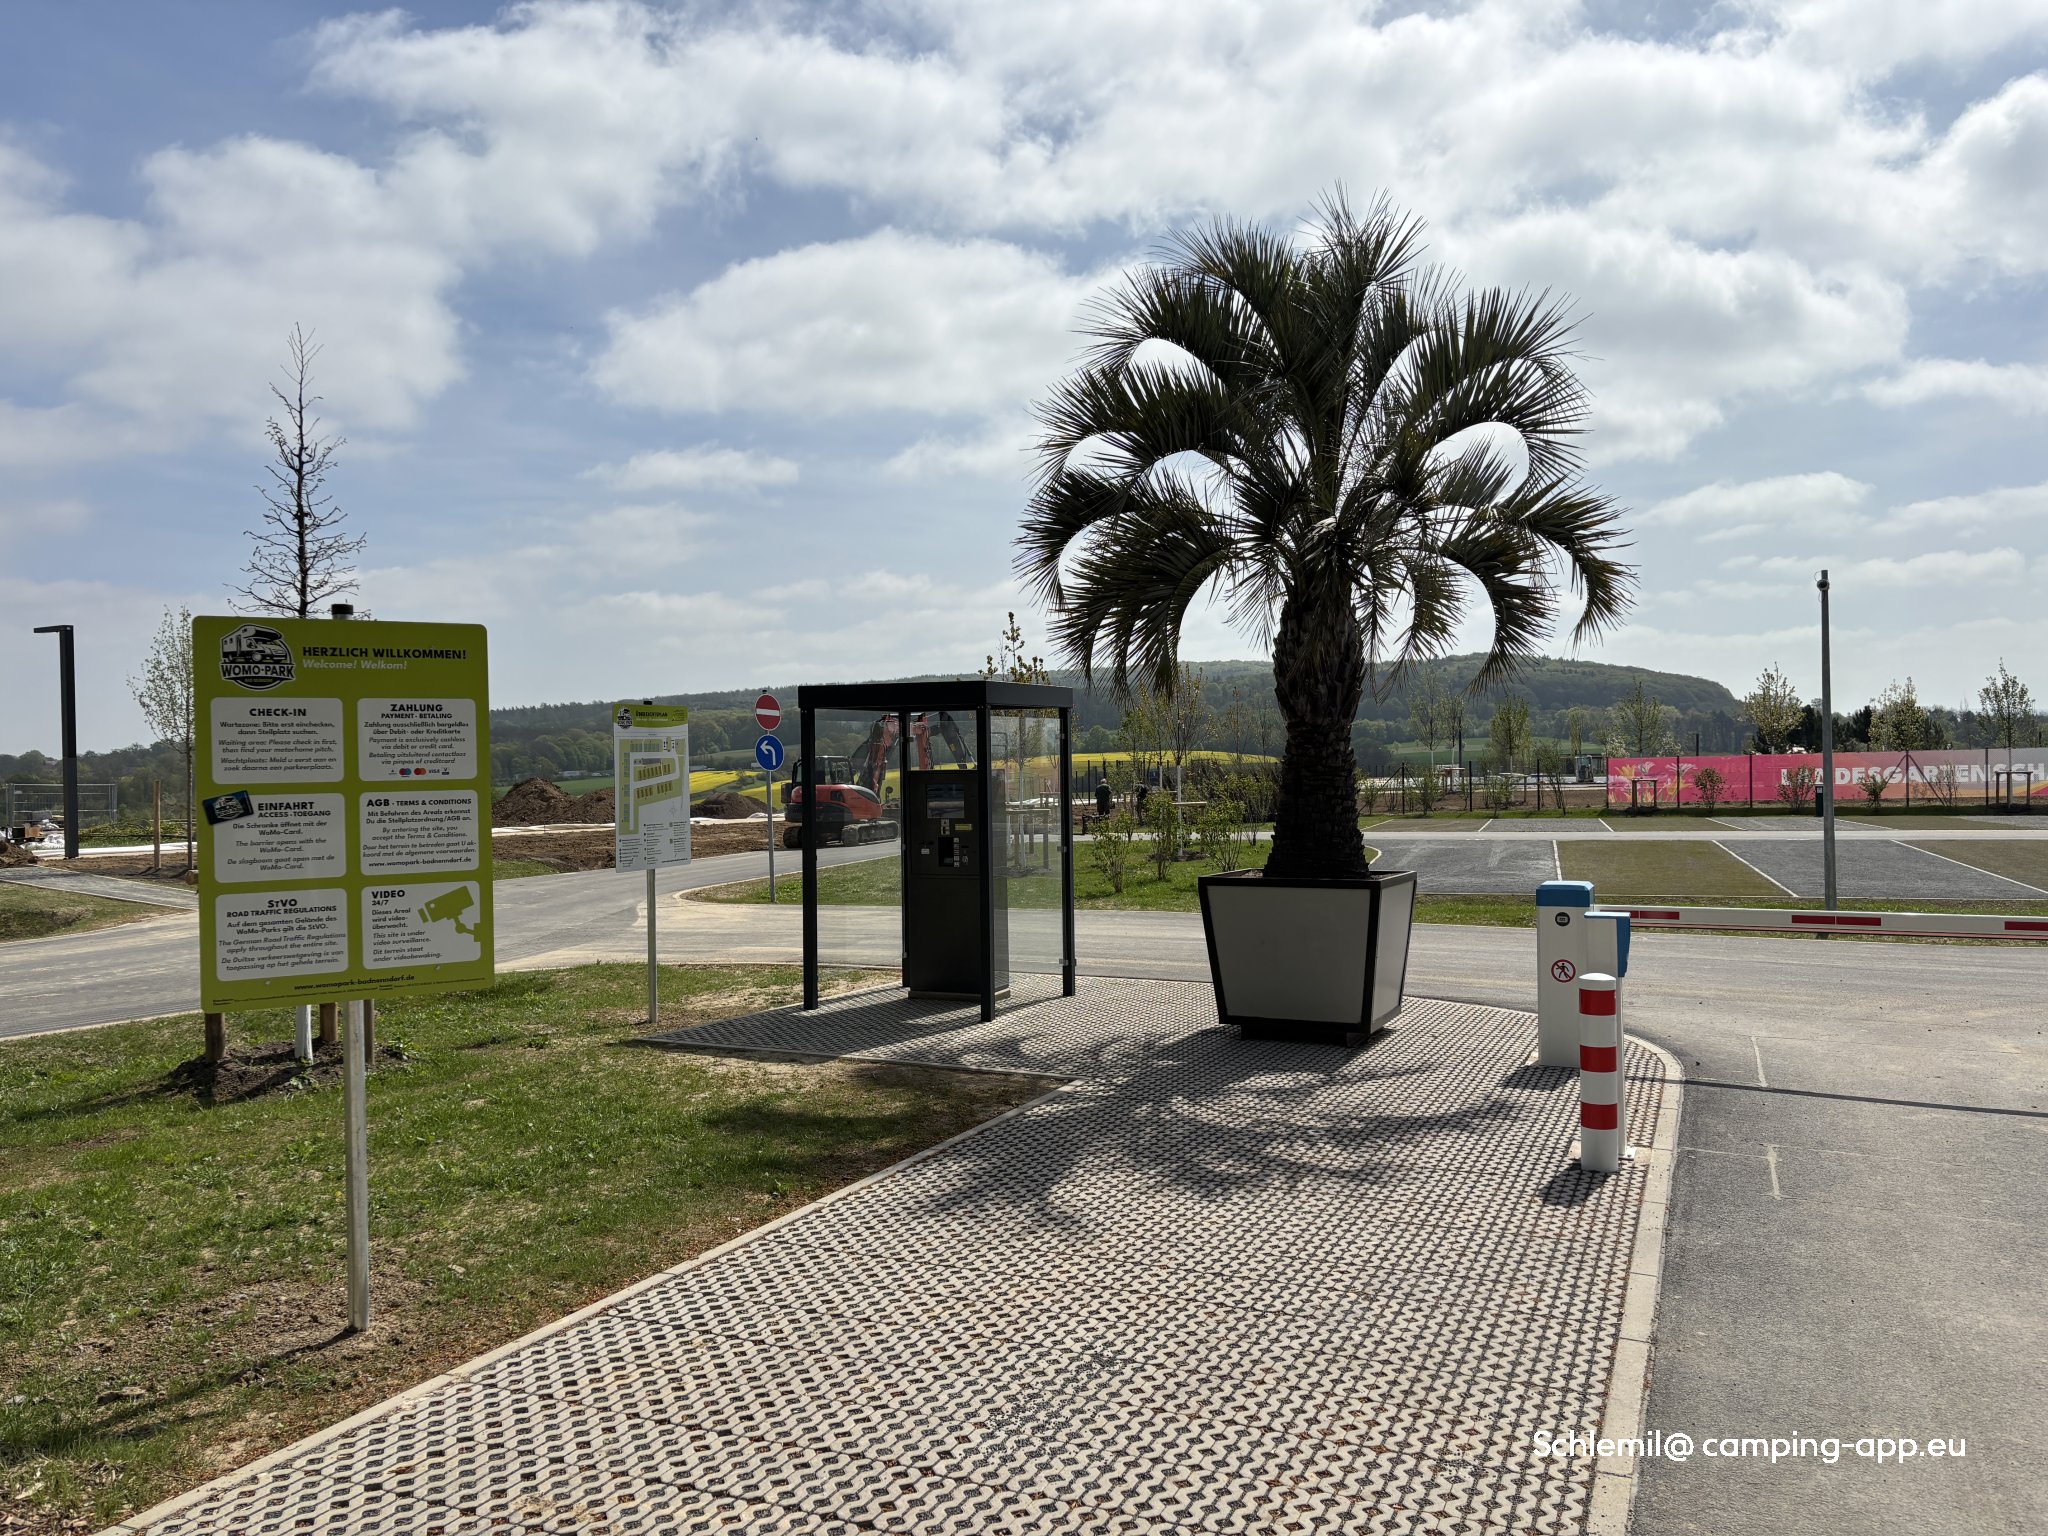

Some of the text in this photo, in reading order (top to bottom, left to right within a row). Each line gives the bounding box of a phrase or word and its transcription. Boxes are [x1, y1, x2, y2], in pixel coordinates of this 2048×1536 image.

[303, 647, 466, 659] HERZLICH WILLKOMMEN!
[303, 659, 407, 669] Welcome! Welkom!
[223, 664, 294, 678] WOMO-PARK
[258, 802, 314, 810] EINFAHRT
[367, 799, 390, 807] AGB
[372, 890, 405, 899] VIDEO
[284, 906, 336, 914] REGULATIONS
